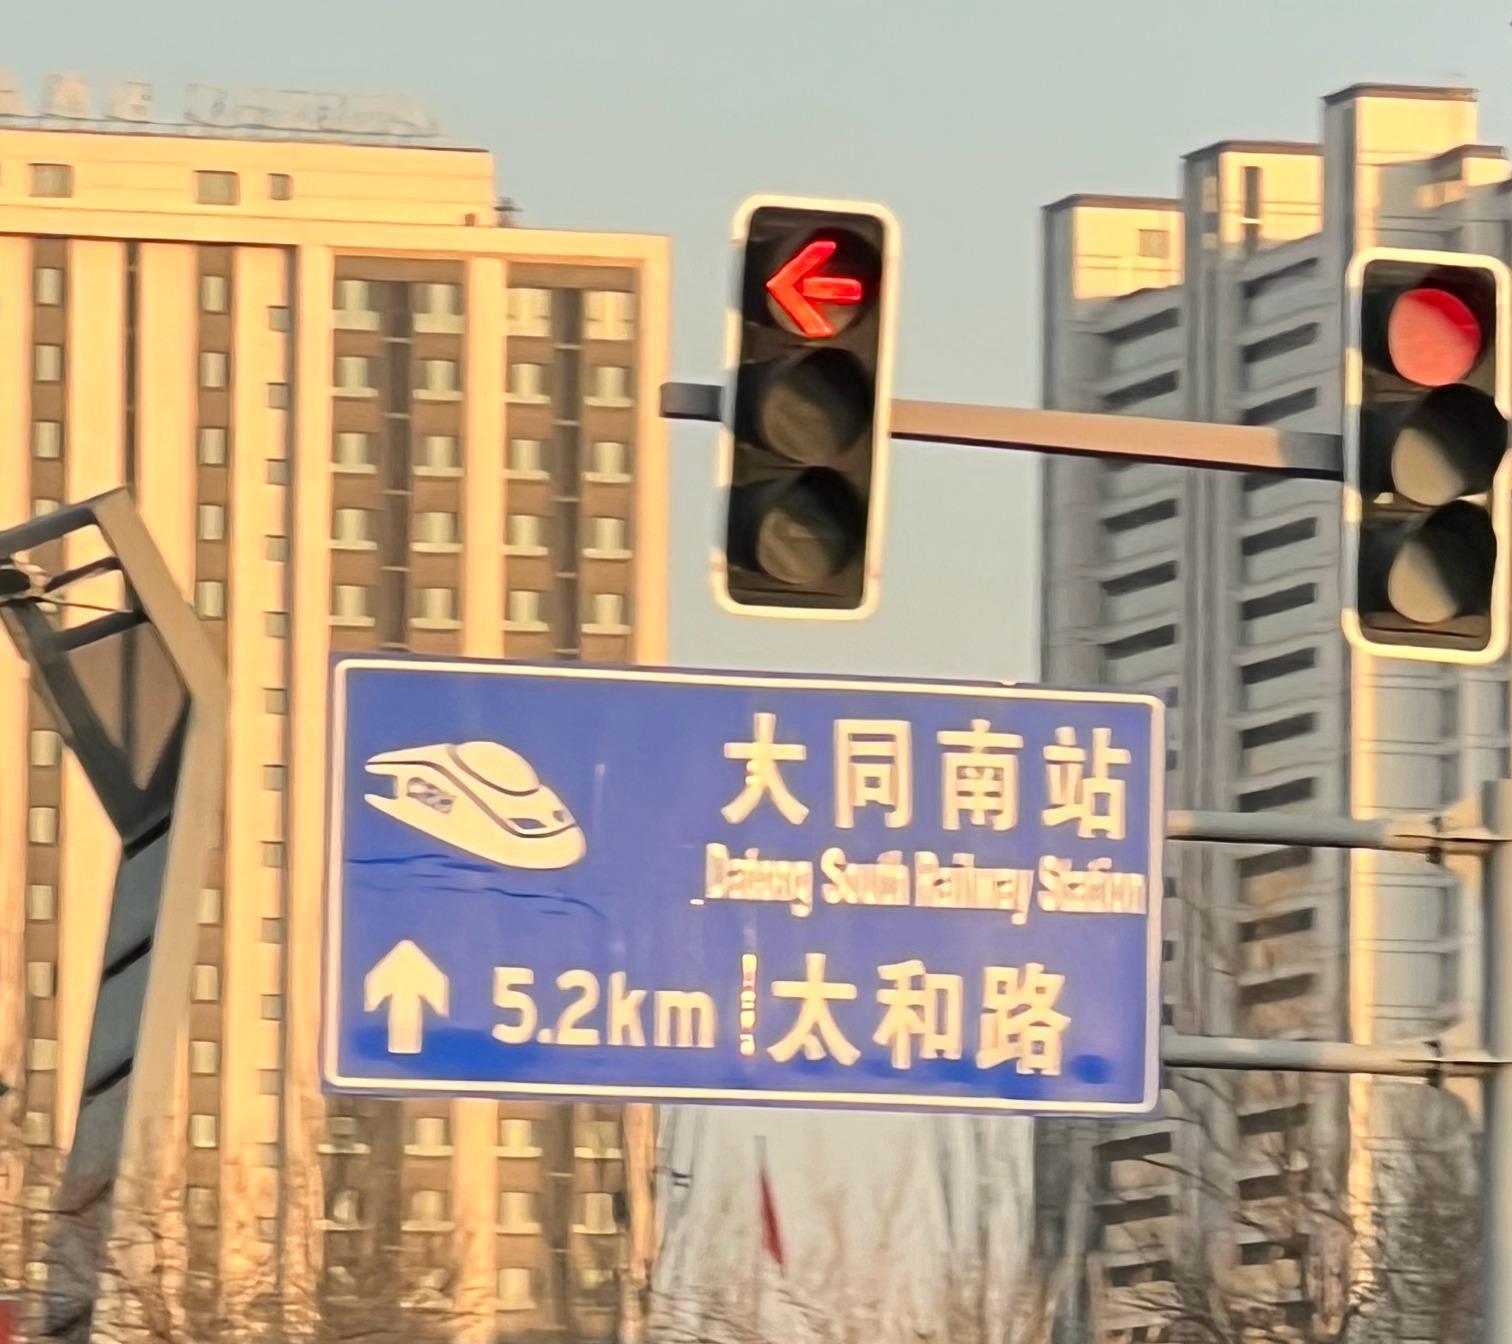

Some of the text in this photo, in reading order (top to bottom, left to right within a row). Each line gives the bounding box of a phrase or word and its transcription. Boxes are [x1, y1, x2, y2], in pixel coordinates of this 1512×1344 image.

[721, 712, 1132, 840] 大同南站
[492, 967, 718, 1049] 5.2km
[767, 953, 1072, 1076] 太和路
